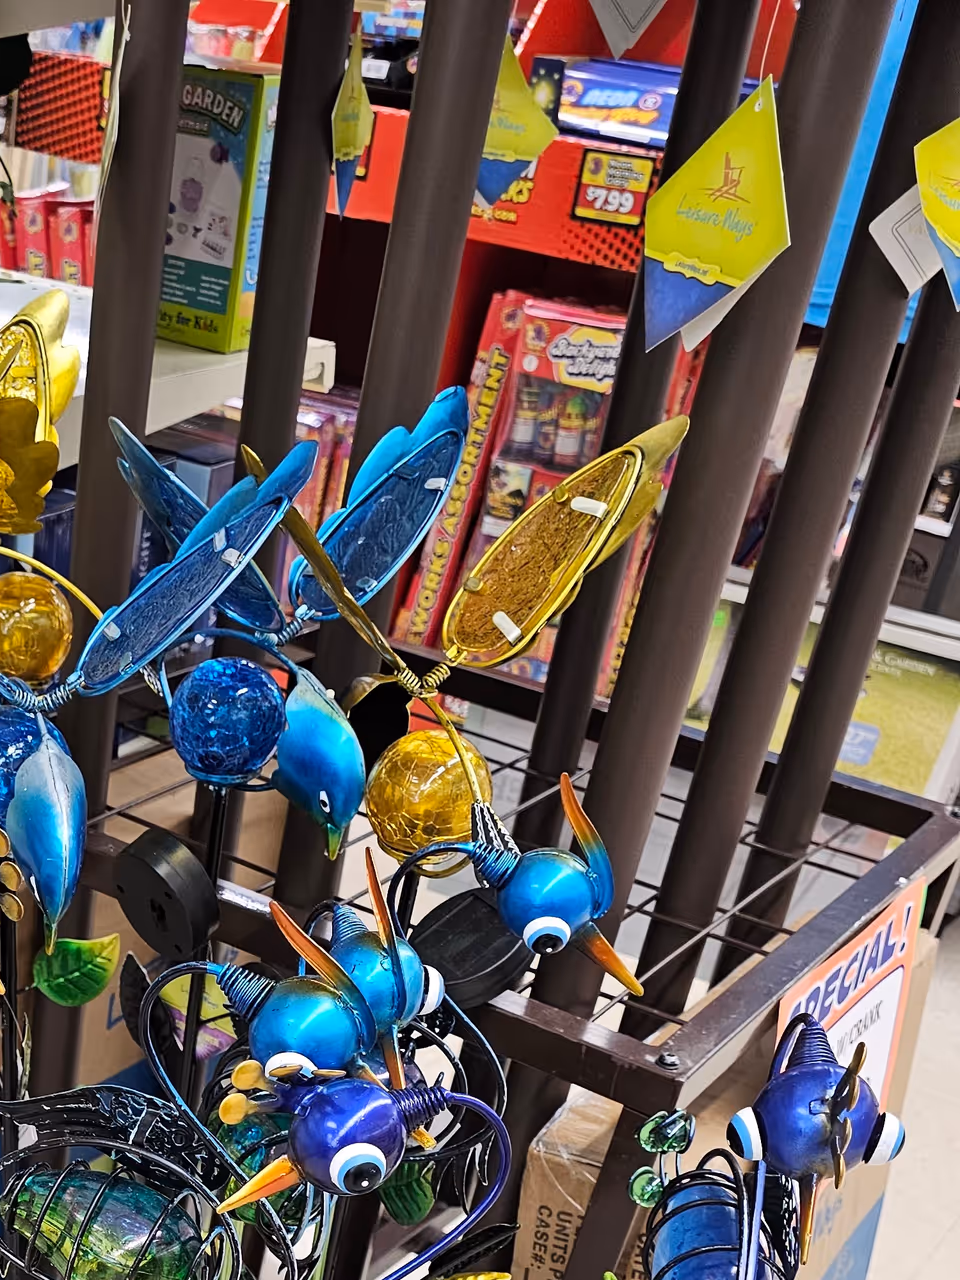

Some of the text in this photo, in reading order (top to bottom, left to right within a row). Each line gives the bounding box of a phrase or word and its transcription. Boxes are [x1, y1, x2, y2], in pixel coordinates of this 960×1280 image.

[181, 84, 244, 129] GARDEN
[585, 185, 635, 215] $7.99
[675, 192, 755, 243] Leisure Ways
[550, 336, 620, 364] Backyar
[439, 344, 512, 538] ASSORTMENT
[530, 1204, 553, 1271] CASE#:
[550, 1210, 574, 1266] UNITS
